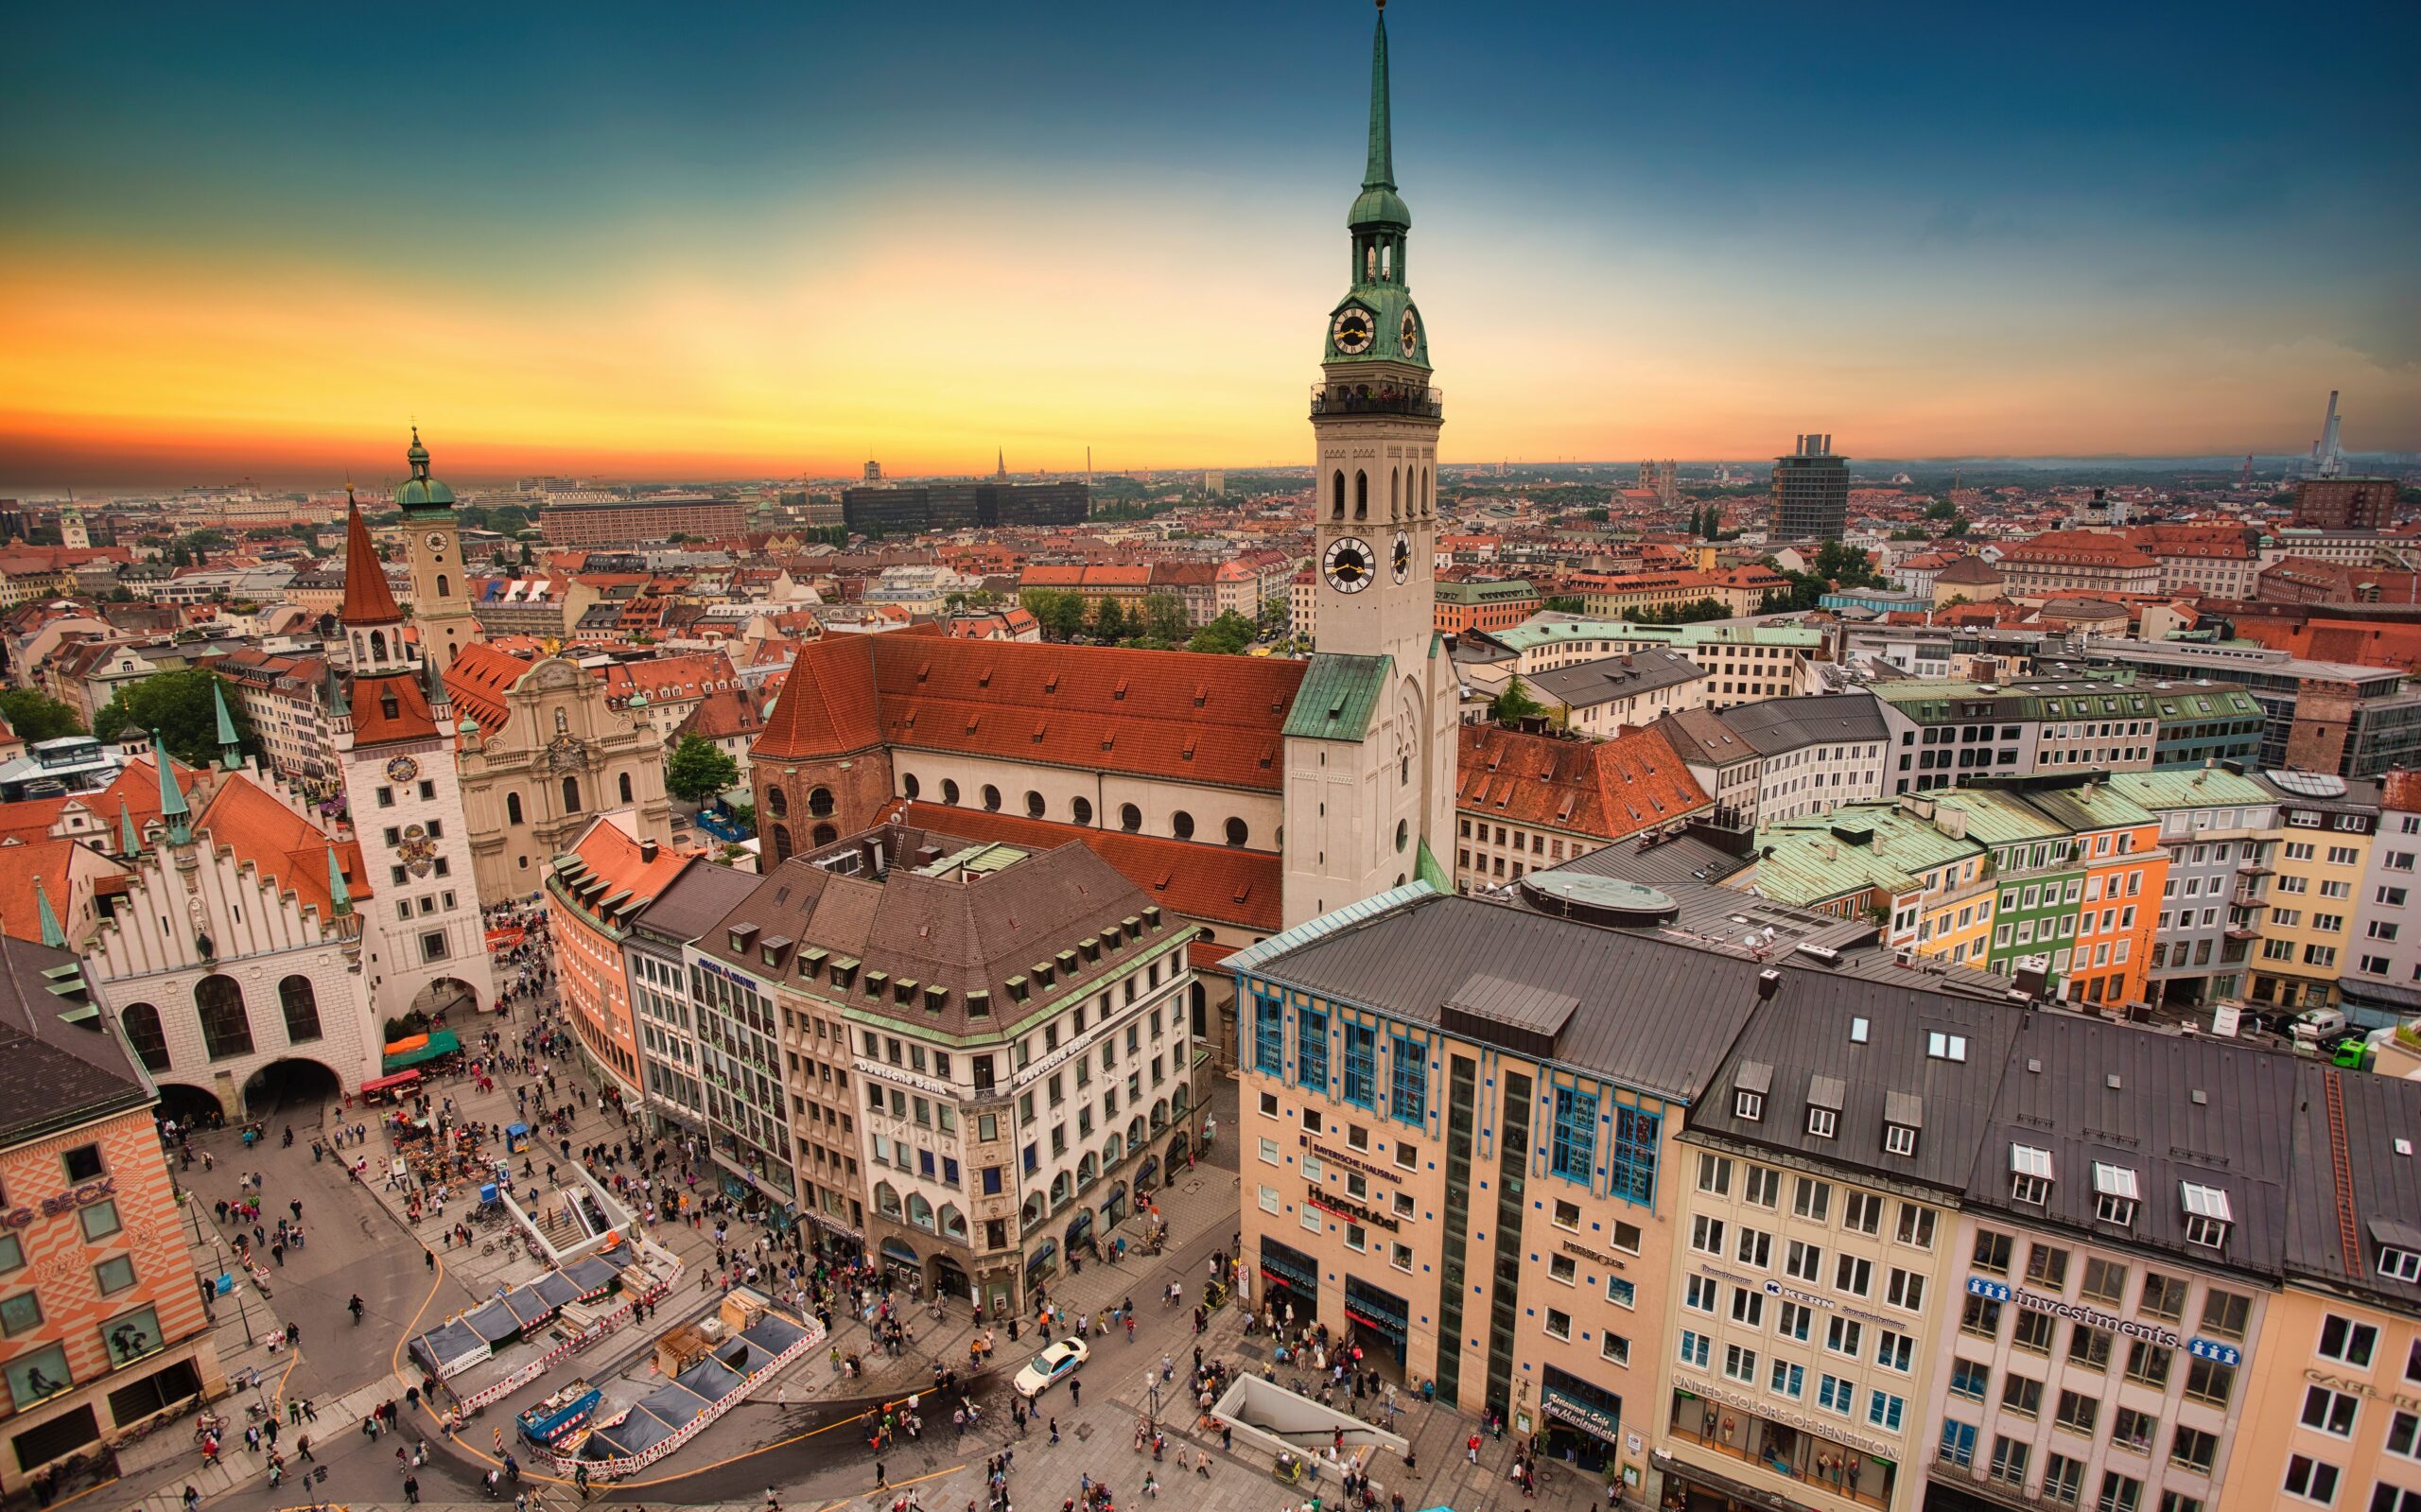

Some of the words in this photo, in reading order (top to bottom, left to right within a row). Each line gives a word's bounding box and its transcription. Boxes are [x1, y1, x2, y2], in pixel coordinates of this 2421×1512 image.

[858, 1060, 913, 1085] Deutsche
[916, 1075, 947, 1095] Bank
[1019, 1051, 1067, 1085] Deutsche
[1069, 1034, 1092, 1052] Bank
[501, 1171, 509, 1179] U
[1314, 1143, 1361, 1169] BAYERISCHE
[1362, 1162, 1402, 1184] HAUSBAU
[43, 1177, 117, 1218] BECK
[1308, 1184, 1400, 1233] Hugendubel
[1784, 1287, 1836, 1310] KERN
[1841, 1305, 1907, 1330] Sprachentraining
[1970, 1277, 2010, 1301] iii
[2191, 1338, 2238, 1364] iii
[1673, 1373, 1723, 1399] UNITED
[1728, 1392, 1786, 1421] COLORS
[1791, 1414, 1812, 1429] OF
[2304, 1368, 2377, 1397] CAFE
[1541, 1400, 1559, 1416] Am
[1559, 1410, 1616, 1442] Marienplatz
[1549, 1393, 1587, 1416] Restaurant
